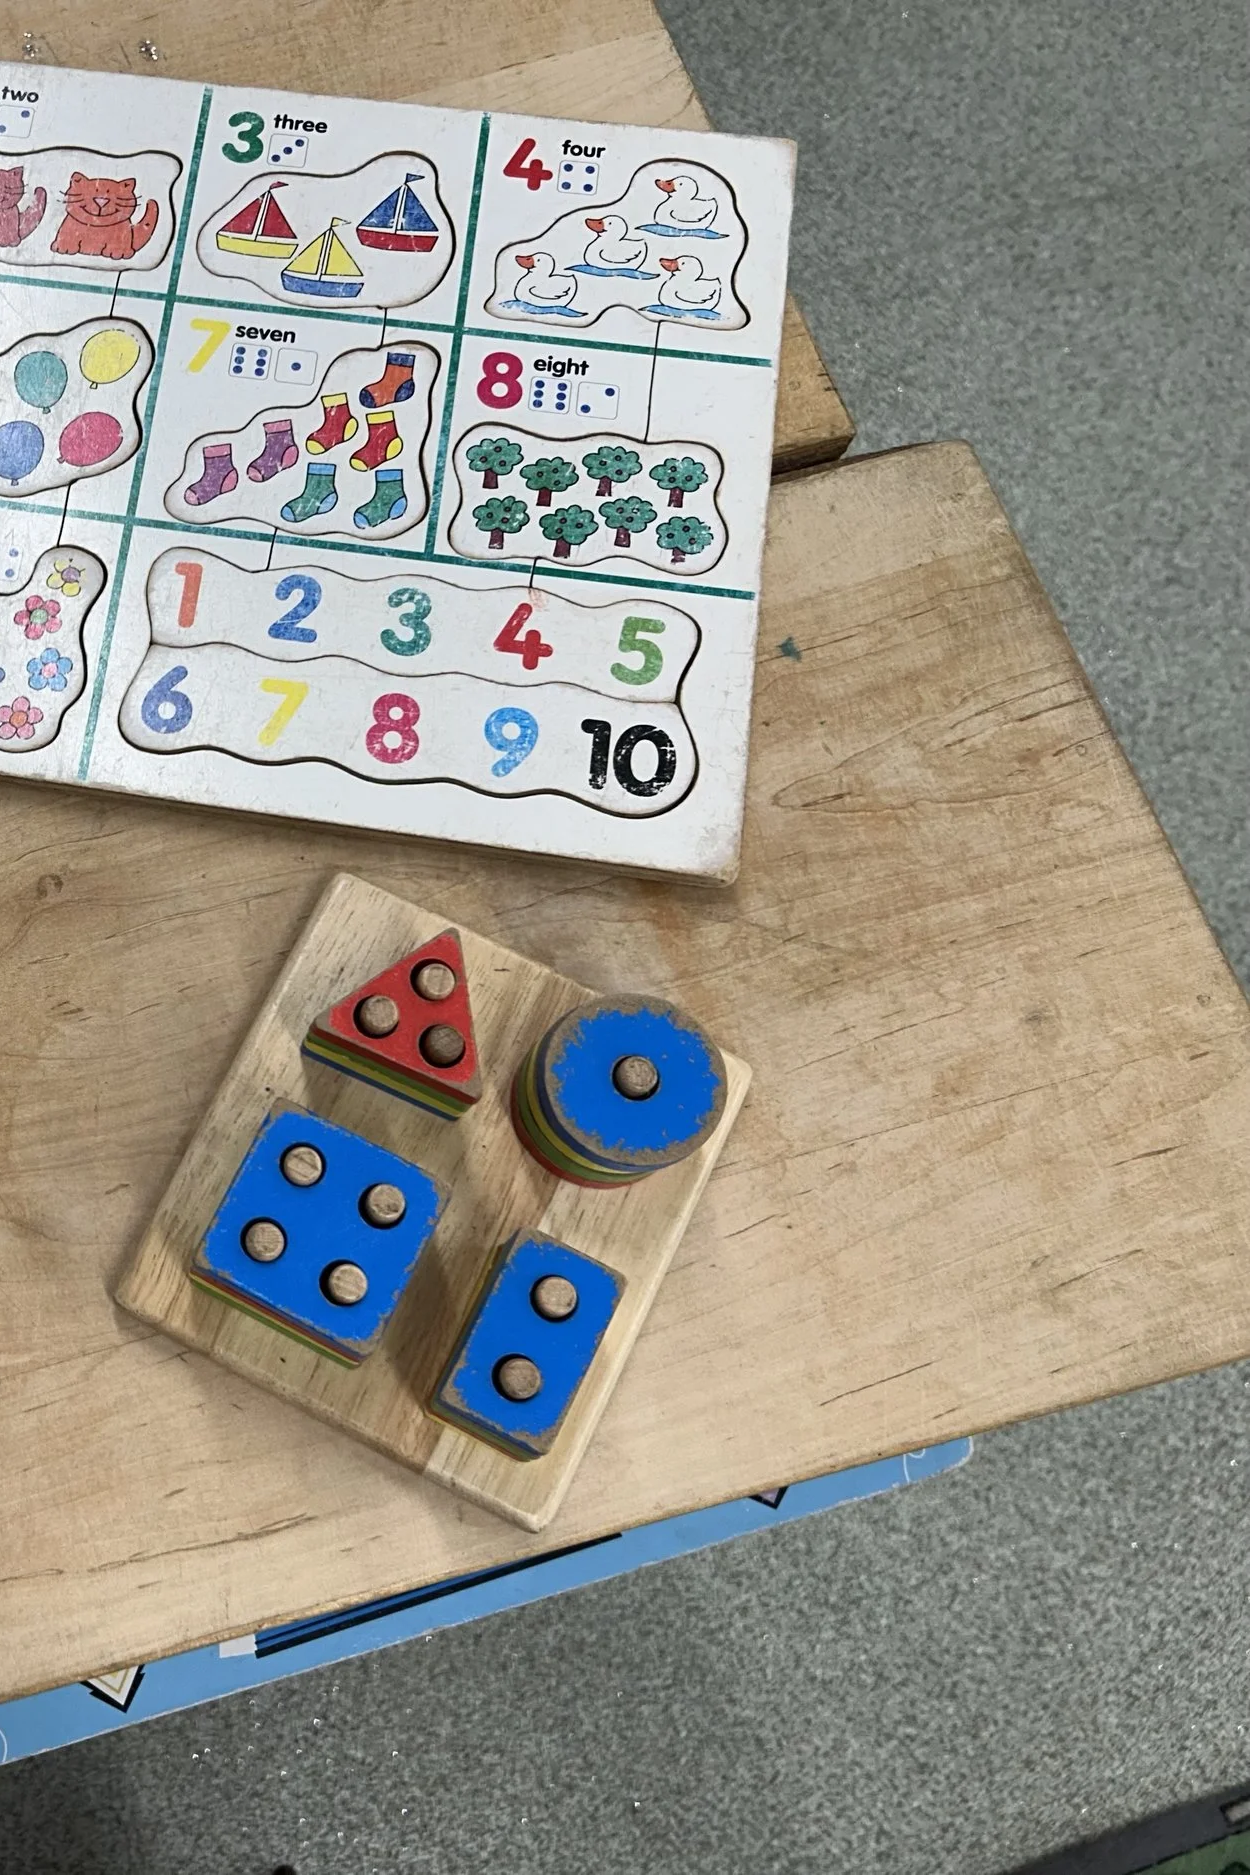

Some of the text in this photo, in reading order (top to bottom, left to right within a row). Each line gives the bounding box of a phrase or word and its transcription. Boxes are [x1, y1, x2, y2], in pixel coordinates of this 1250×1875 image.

[0, 85, 40, 104] two
[221, 111, 328, 164] 3 three
[502, 138, 606, 192] 4 four
[186, 318, 297, 373] 7 seven
[476, 351, 590, 410] 8 eight
[174, 561, 666, 686] 1 2 3 4 5
[140, 665, 678, 798] 6 7 8 9 10
